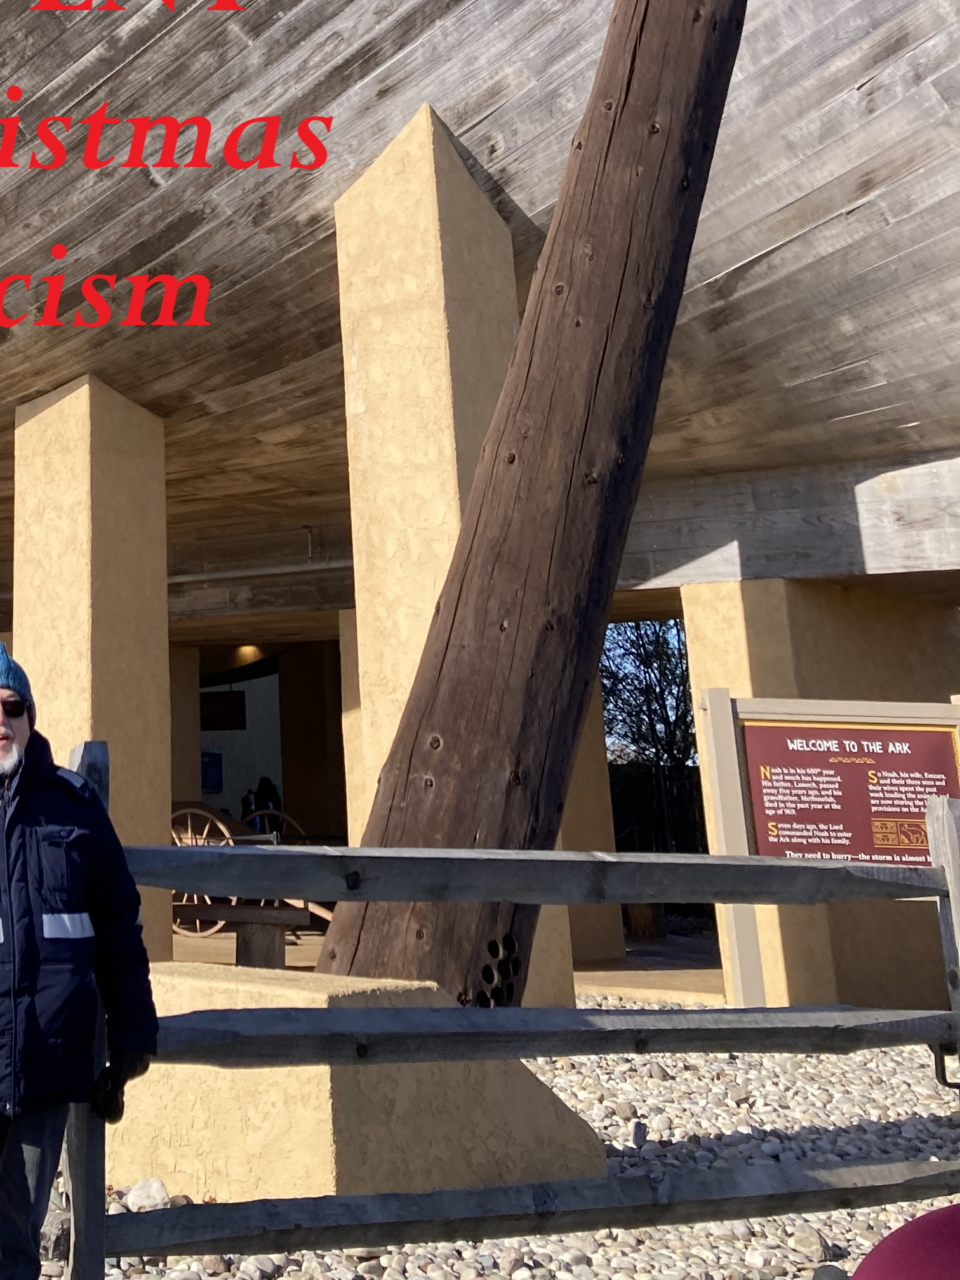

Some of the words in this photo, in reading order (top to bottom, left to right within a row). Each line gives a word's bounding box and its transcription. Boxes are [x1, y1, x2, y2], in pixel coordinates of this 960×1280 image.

[787, 738, 840, 752] WELCOME
[843, 740, 858, 752] TO
[861, 741, 883, 753] THE
[888, 742, 911, 754] ARK
[902, 854, 926, 862] almost
